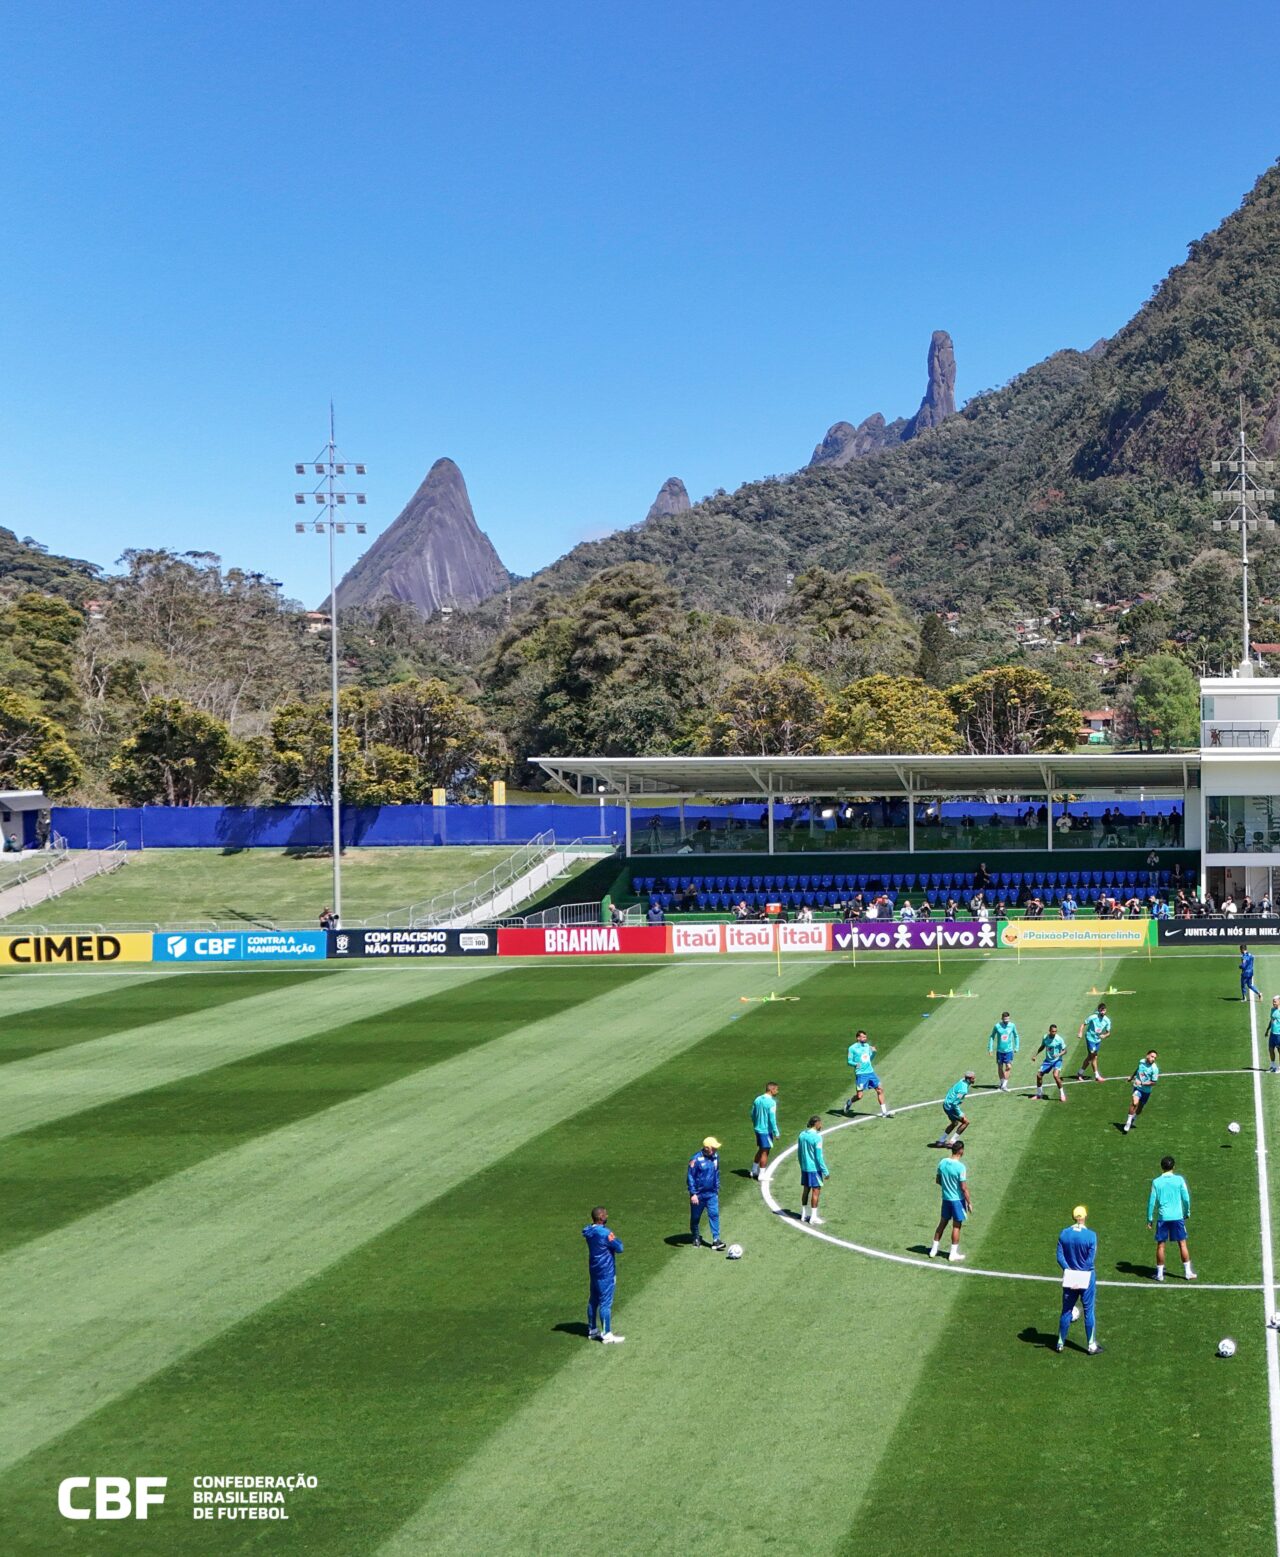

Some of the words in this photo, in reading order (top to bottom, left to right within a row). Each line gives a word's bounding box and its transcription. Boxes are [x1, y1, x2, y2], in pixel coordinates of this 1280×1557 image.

[364, 932, 391, 943] COM
[393, 931, 446, 942] RACISMO
[676, 928, 716, 947] itaú
[729, 927, 769, 946] itaú
[783, 926, 823, 944] itaú
[835, 927, 890, 948] vivo
[919, 925, 974, 946] vivo
[1023, 930, 1141, 940] #PaixãoPelaAmarelinha
[1184, 928, 1218, 937] JUNTE-SE
[1219, 928, 1226, 936] A
[1227, 926, 1243, 936] NÓS
[1245, 928, 1257, 936] EM
[247, 936, 285, 944] CONTRA
[287, 936, 295, 944] A
[544, 928, 620, 952] BRAHMA
[8, 935, 121, 963] CIMED
[194, 938, 236, 955] CBF
[247, 943, 316, 955] MANIPULAÇÃO
[365, 942, 391, 954] NÃO
[391, 944, 415, 953] TEM
[416, 943, 446, 953] JOGO
